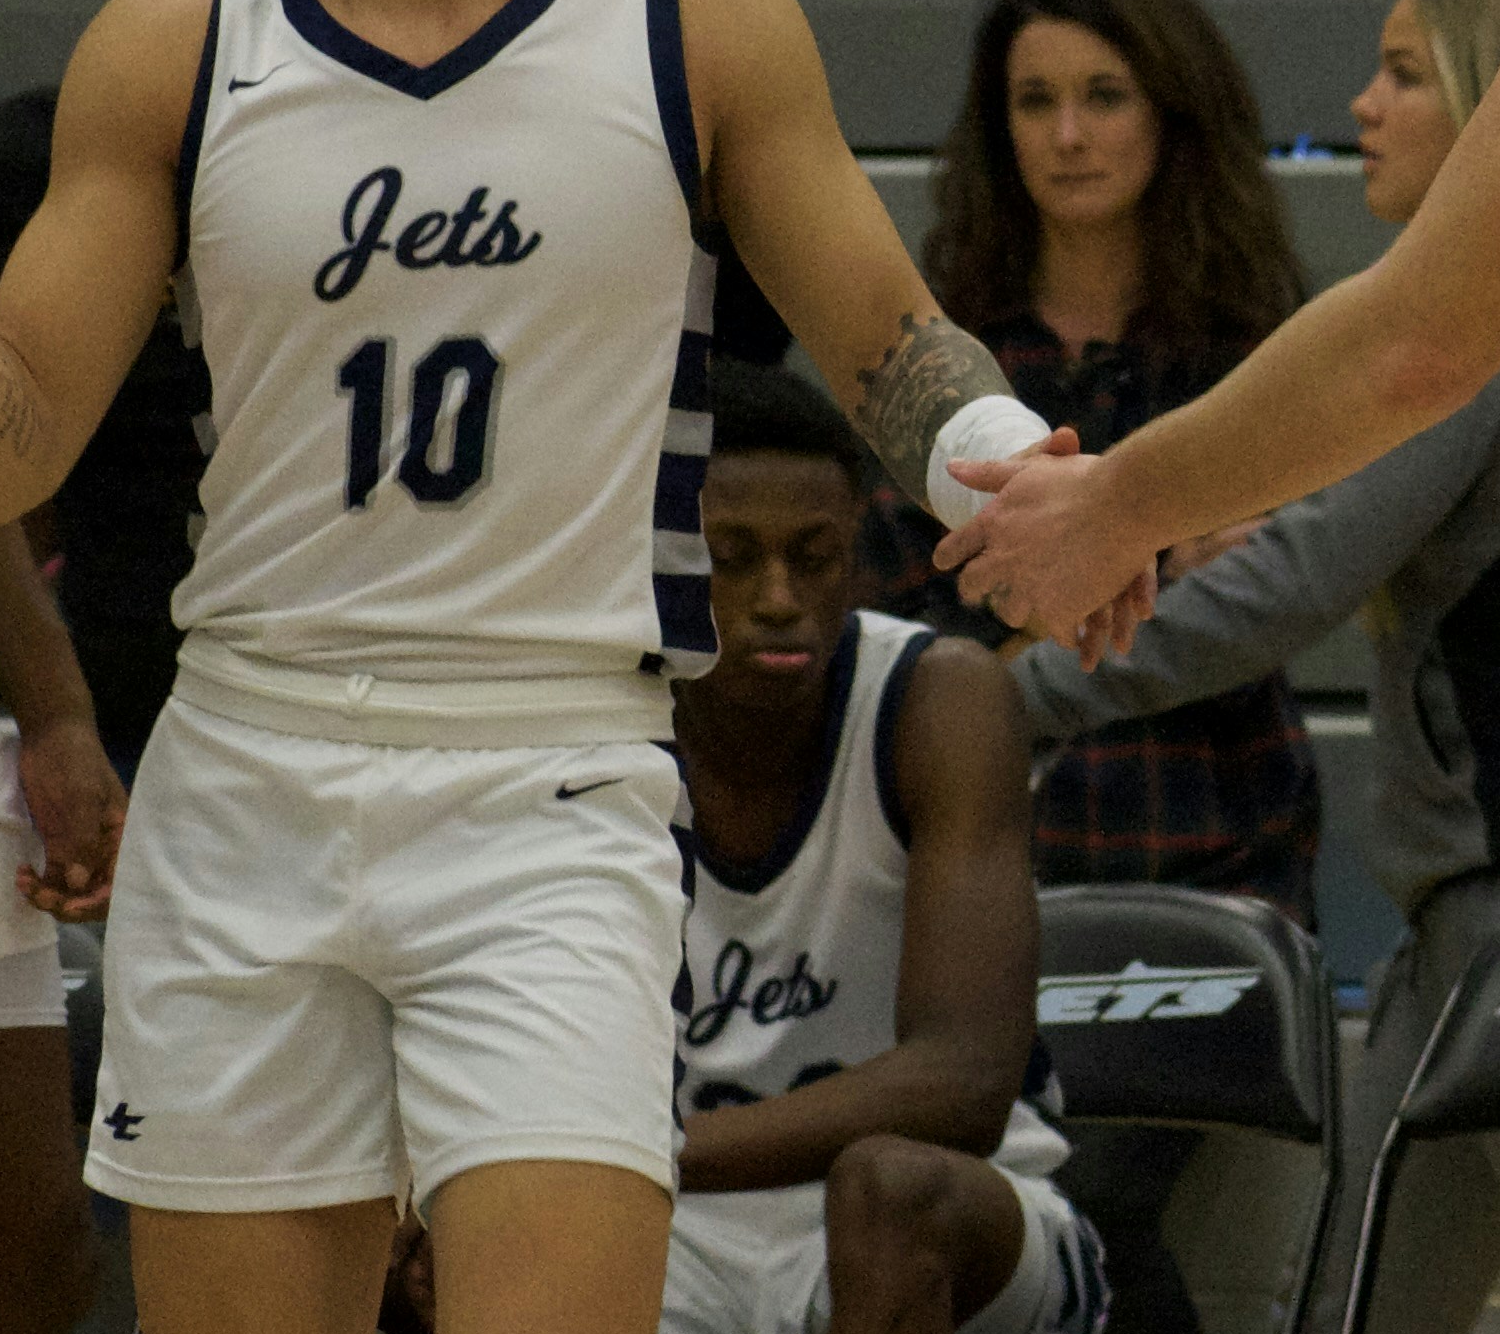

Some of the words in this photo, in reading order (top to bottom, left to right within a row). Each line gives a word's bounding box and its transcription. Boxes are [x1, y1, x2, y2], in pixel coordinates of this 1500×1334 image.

[314, 166, 542, 302] Jets
[336, 334, 505, 512] 10
[1037, 960, 1264, 1025] ETS
